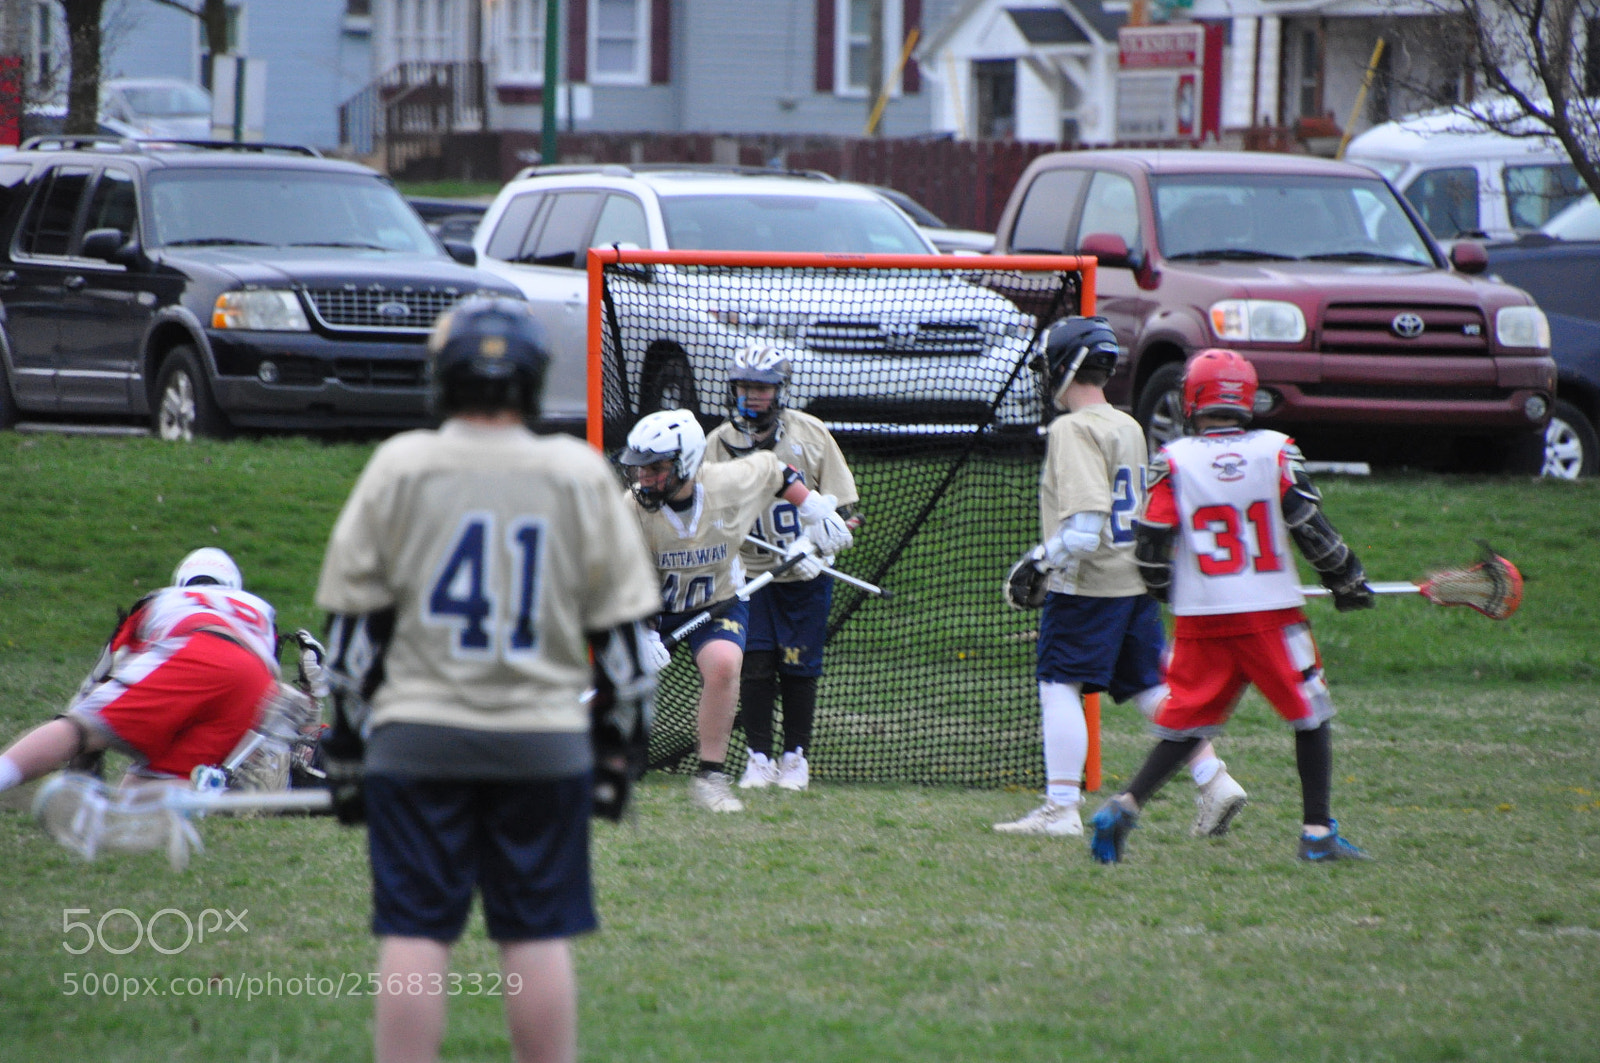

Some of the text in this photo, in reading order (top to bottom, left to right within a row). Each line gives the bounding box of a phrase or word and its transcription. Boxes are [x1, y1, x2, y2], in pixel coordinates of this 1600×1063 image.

[1110, 464, 1148, 547] 2
[1192, 500, 1283, 576] 31
[423, 514, 546, 658] 41
[655, 543, 728, 568] ATTAWAN
